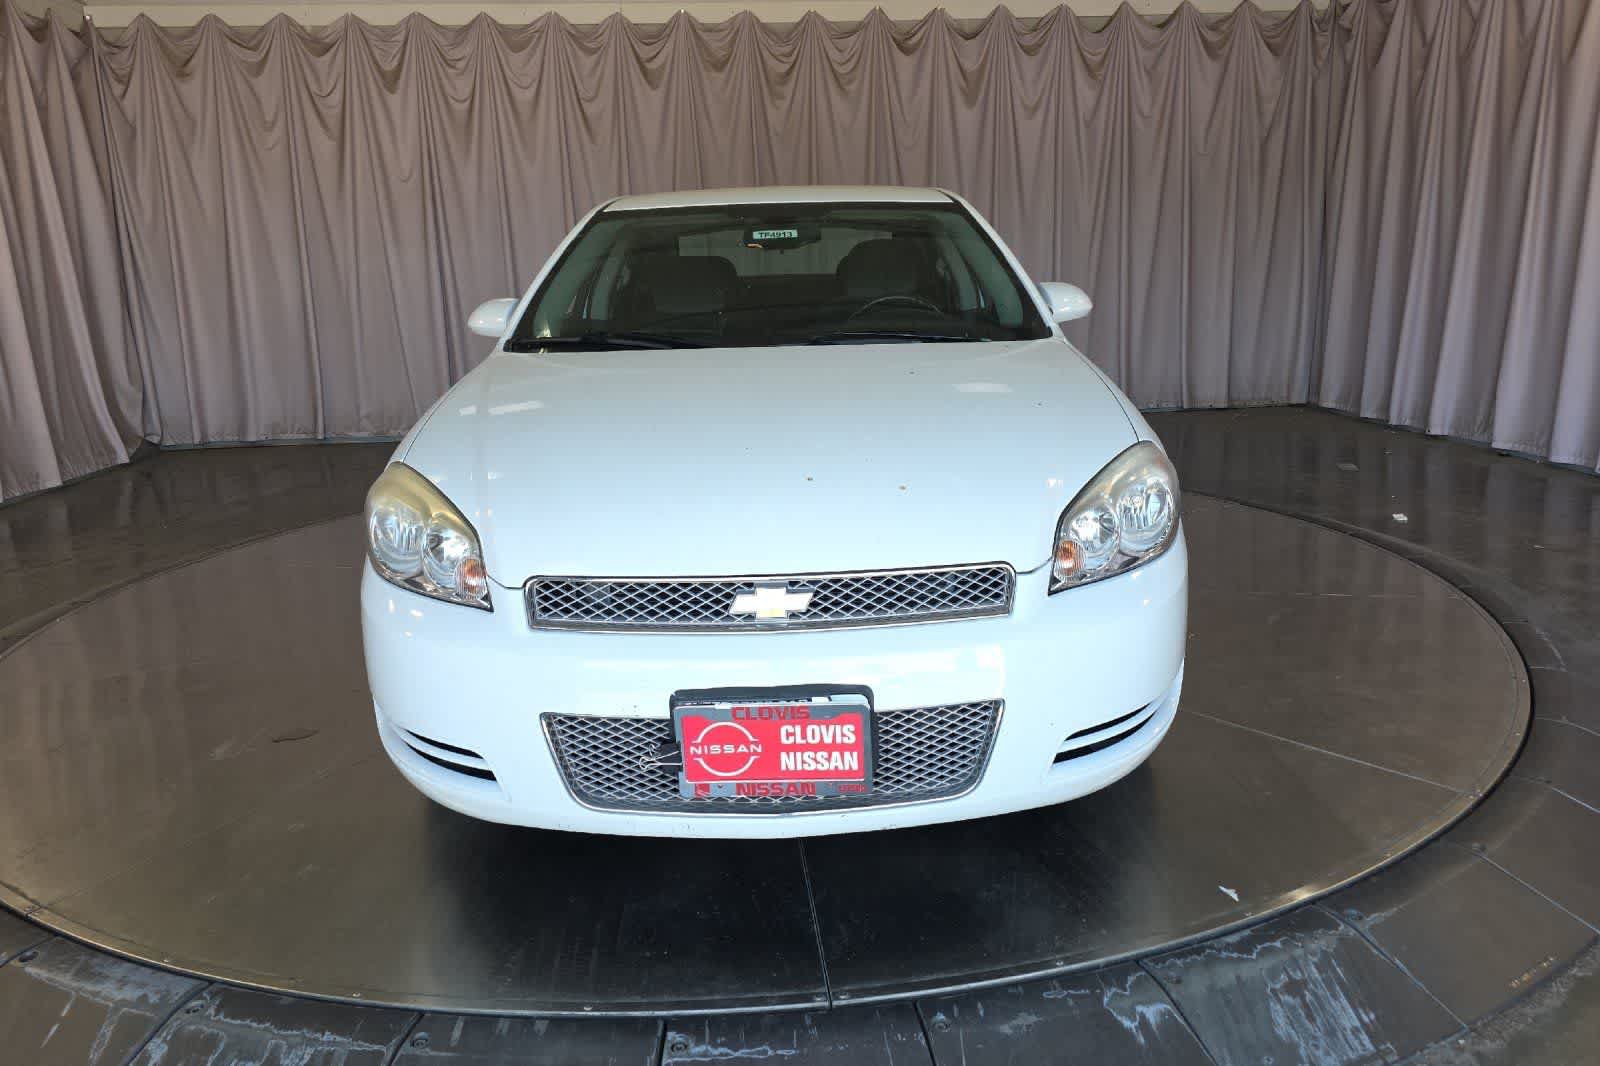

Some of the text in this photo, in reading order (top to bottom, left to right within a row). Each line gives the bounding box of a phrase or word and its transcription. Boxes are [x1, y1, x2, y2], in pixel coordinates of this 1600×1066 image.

[731, 706, 810, 721] CLOVIS
[780, 725, 856, 745] CLOVIS
[690, 744, 763, 755] NISSAN
[780, 751, 859, 771] NISSAN
[735, 782, 817, 797] NISSAN
